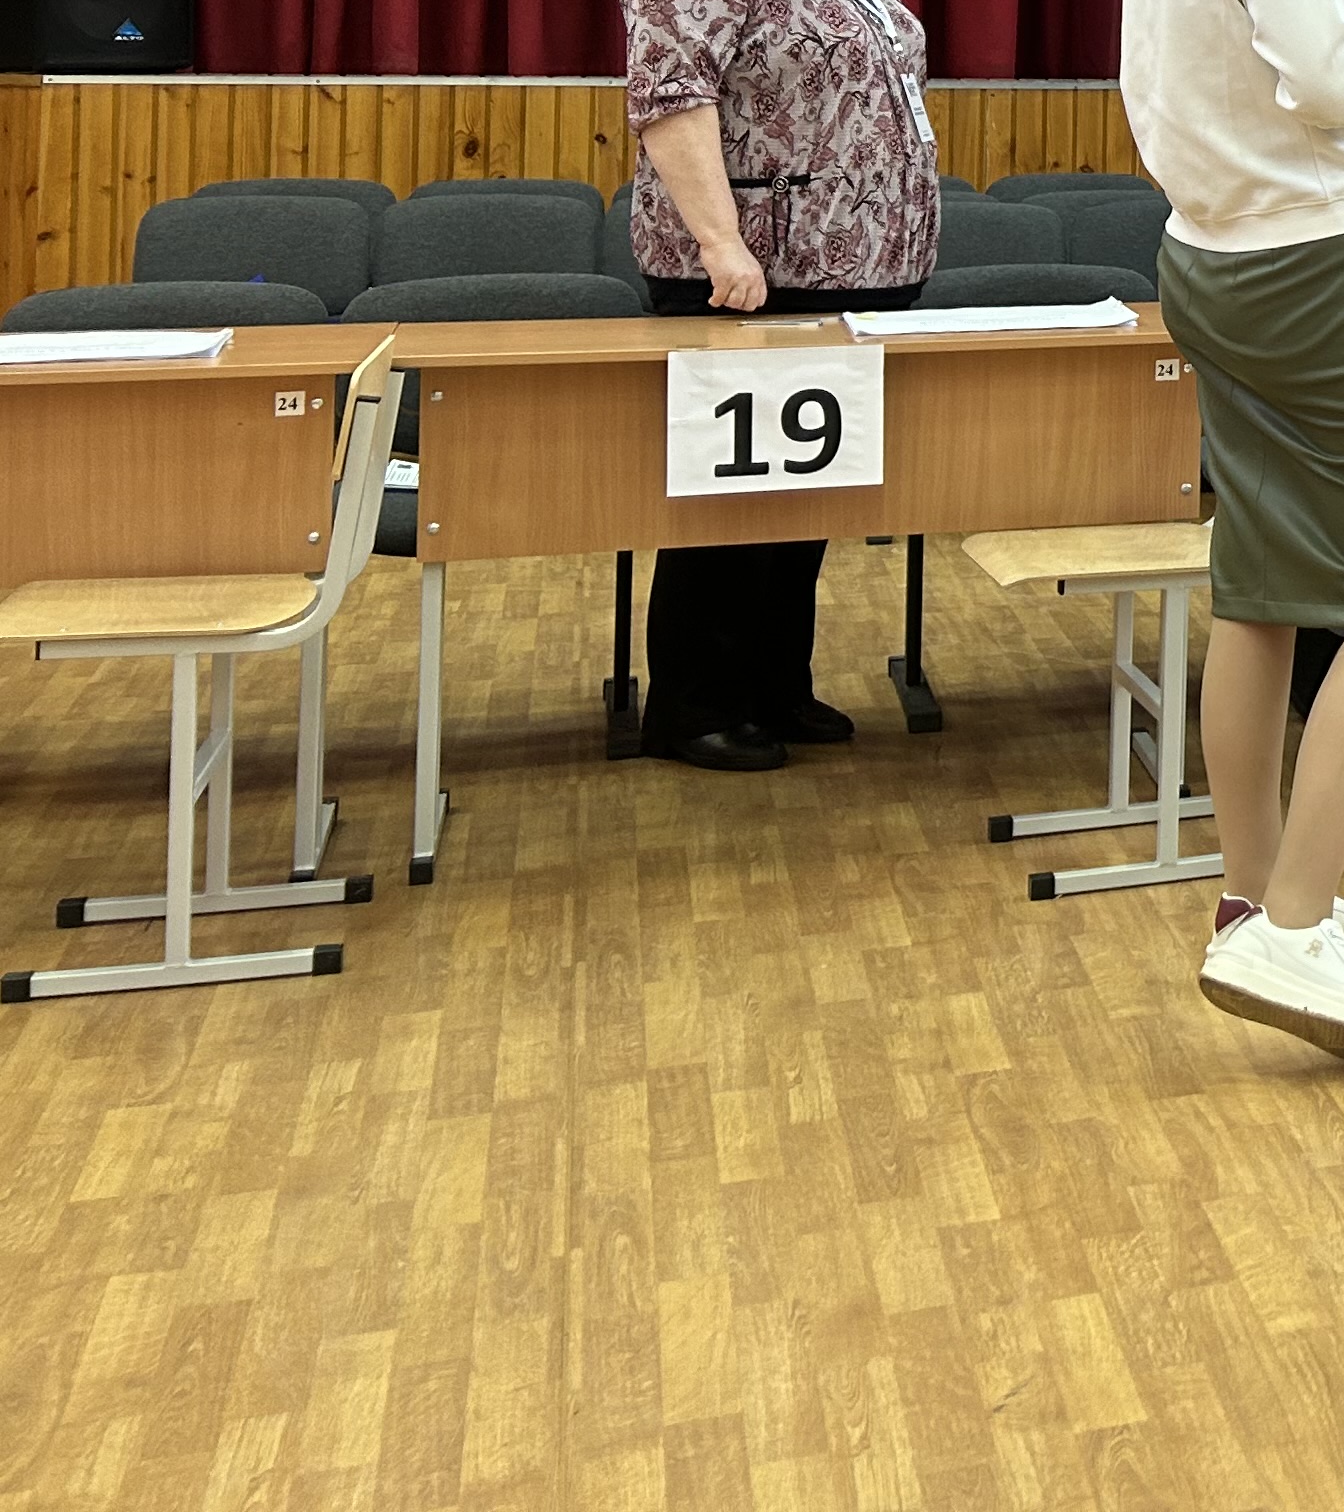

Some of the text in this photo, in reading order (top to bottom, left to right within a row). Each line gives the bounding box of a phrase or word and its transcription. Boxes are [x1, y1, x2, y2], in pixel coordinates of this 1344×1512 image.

[1157, 363, 1174, 377] 24
[277, 397, 298, 411] 24
[714, 388, 842, 478] 19
